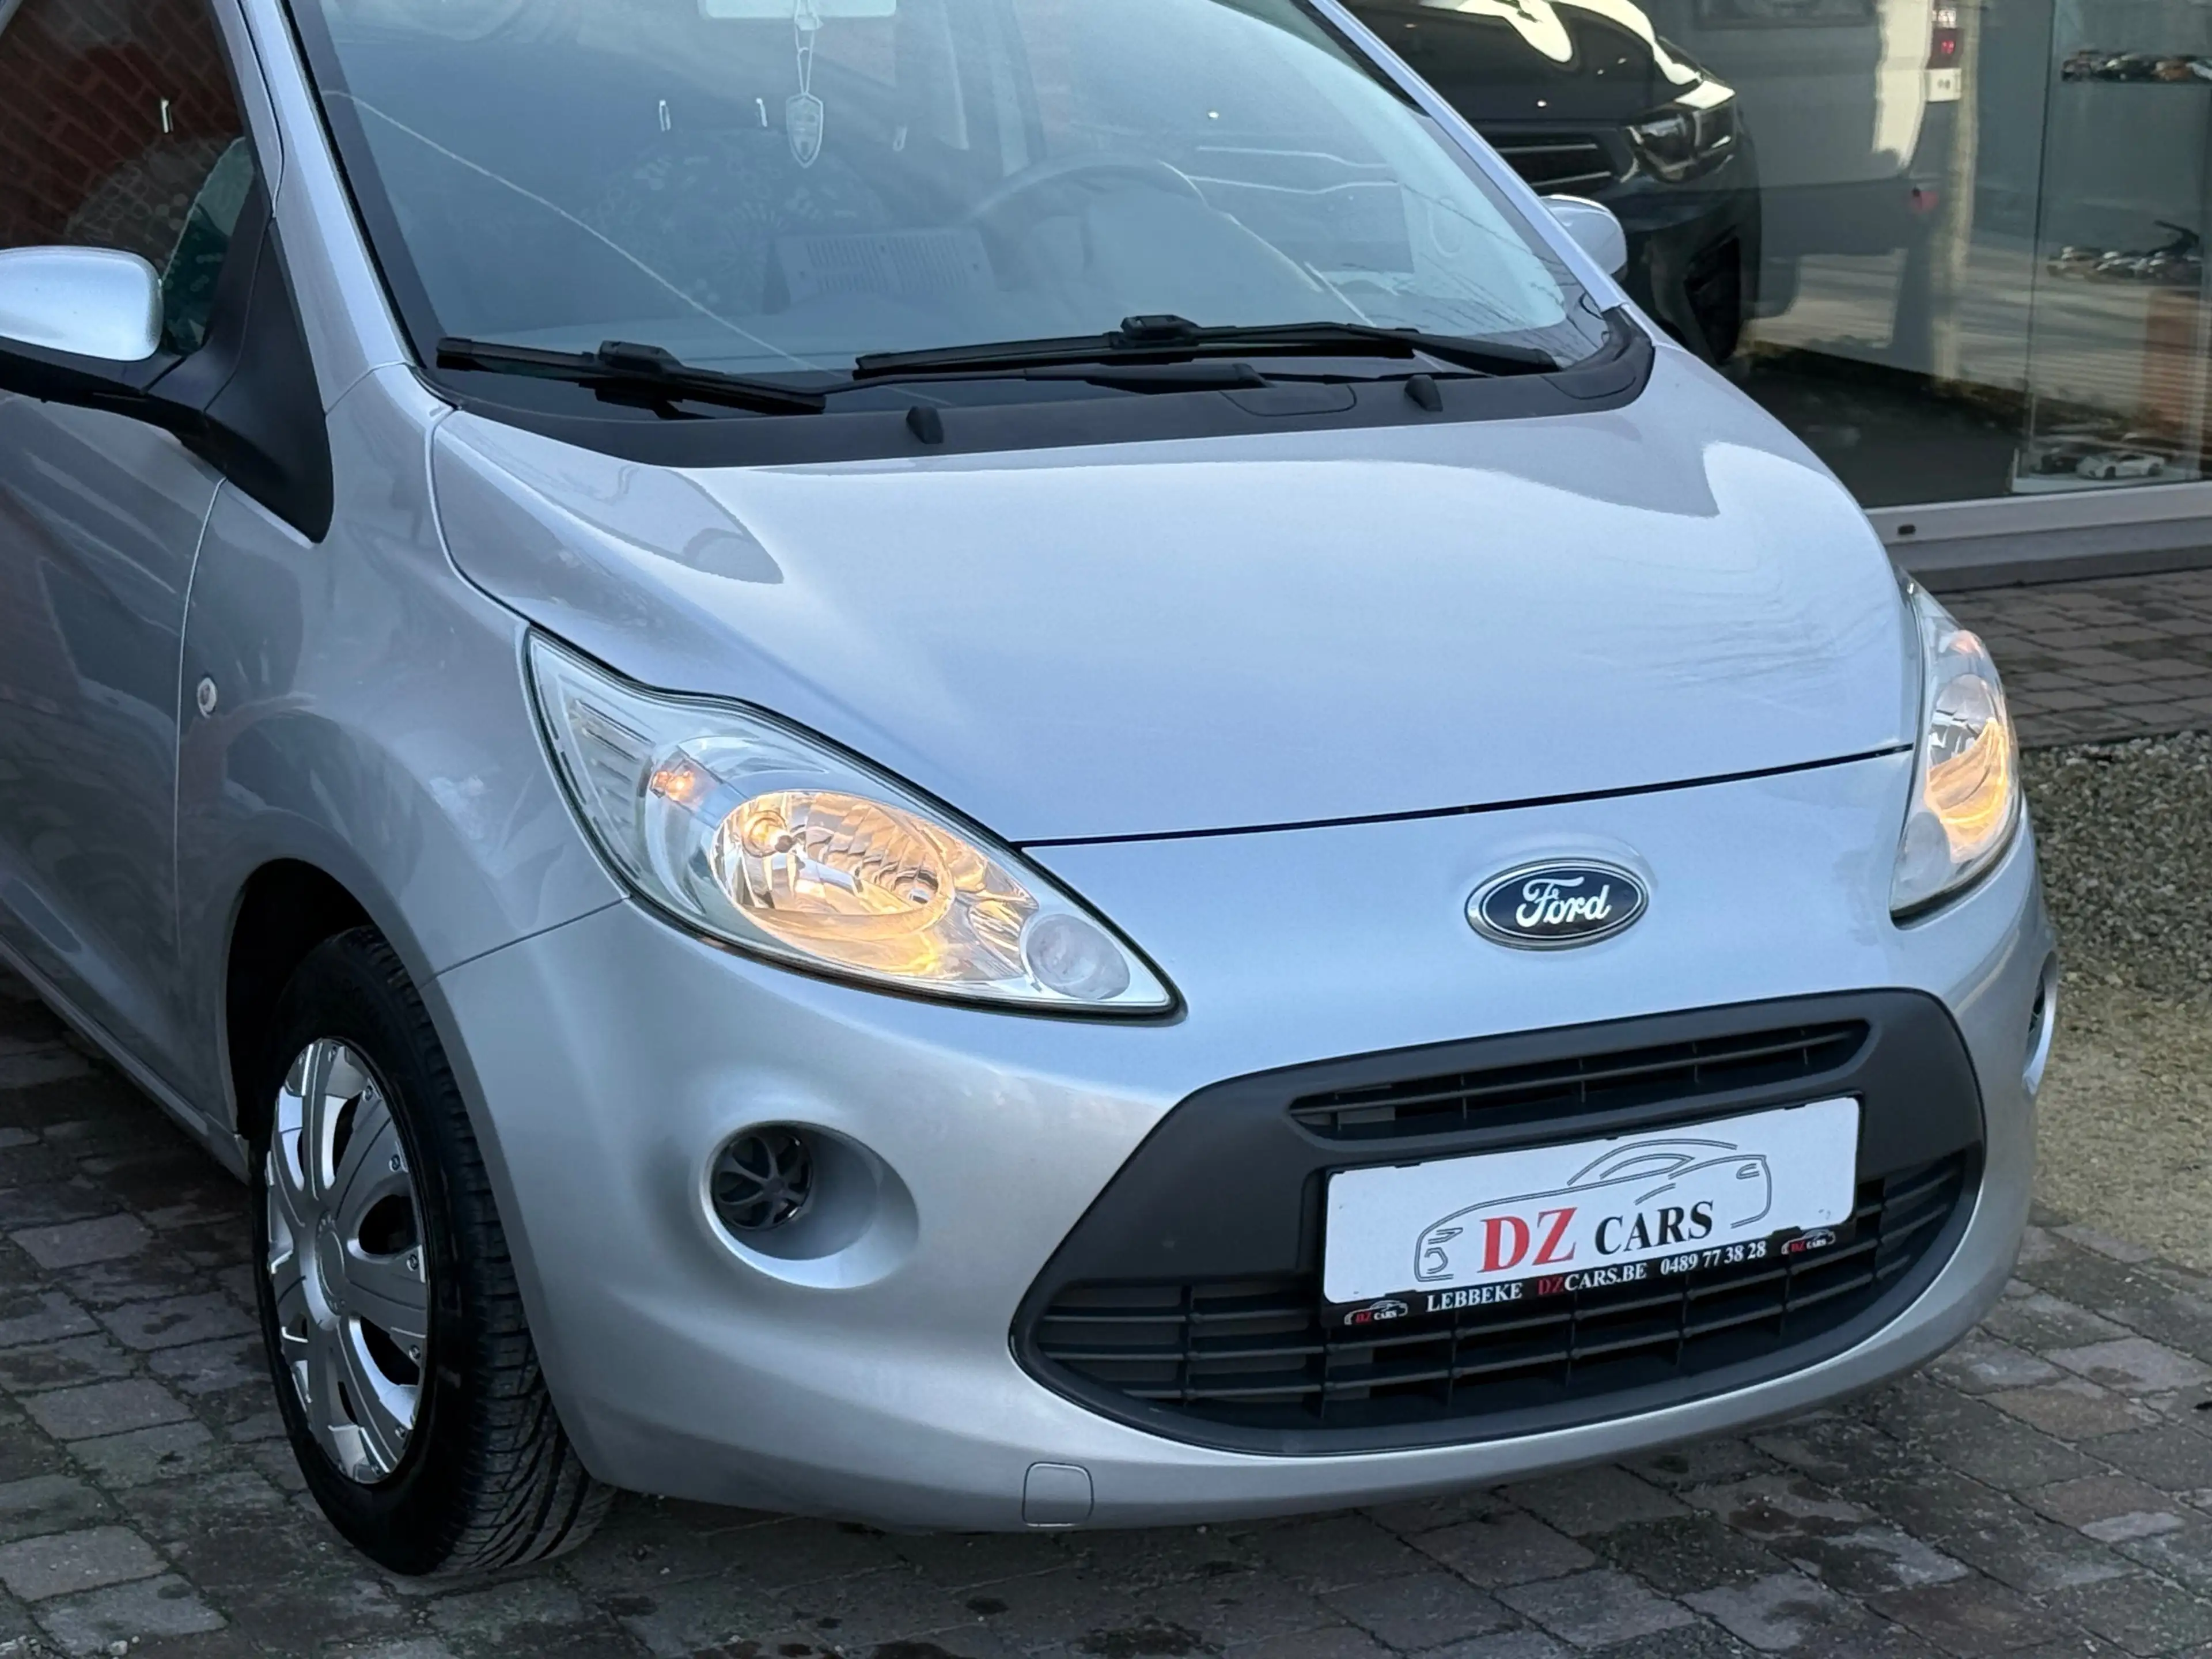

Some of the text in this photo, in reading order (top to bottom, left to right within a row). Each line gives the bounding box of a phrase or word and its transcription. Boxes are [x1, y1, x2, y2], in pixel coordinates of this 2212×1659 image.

[1516, 876, 1612, 928] Ford
[1476, 1200, 1714, 1273] DZ CARS
[1426, 1240, 1767, 1312] LEBBEKE DZCARS.BE 0489 77 38 28
[1373, 1310, 1397, 1320] CARS
